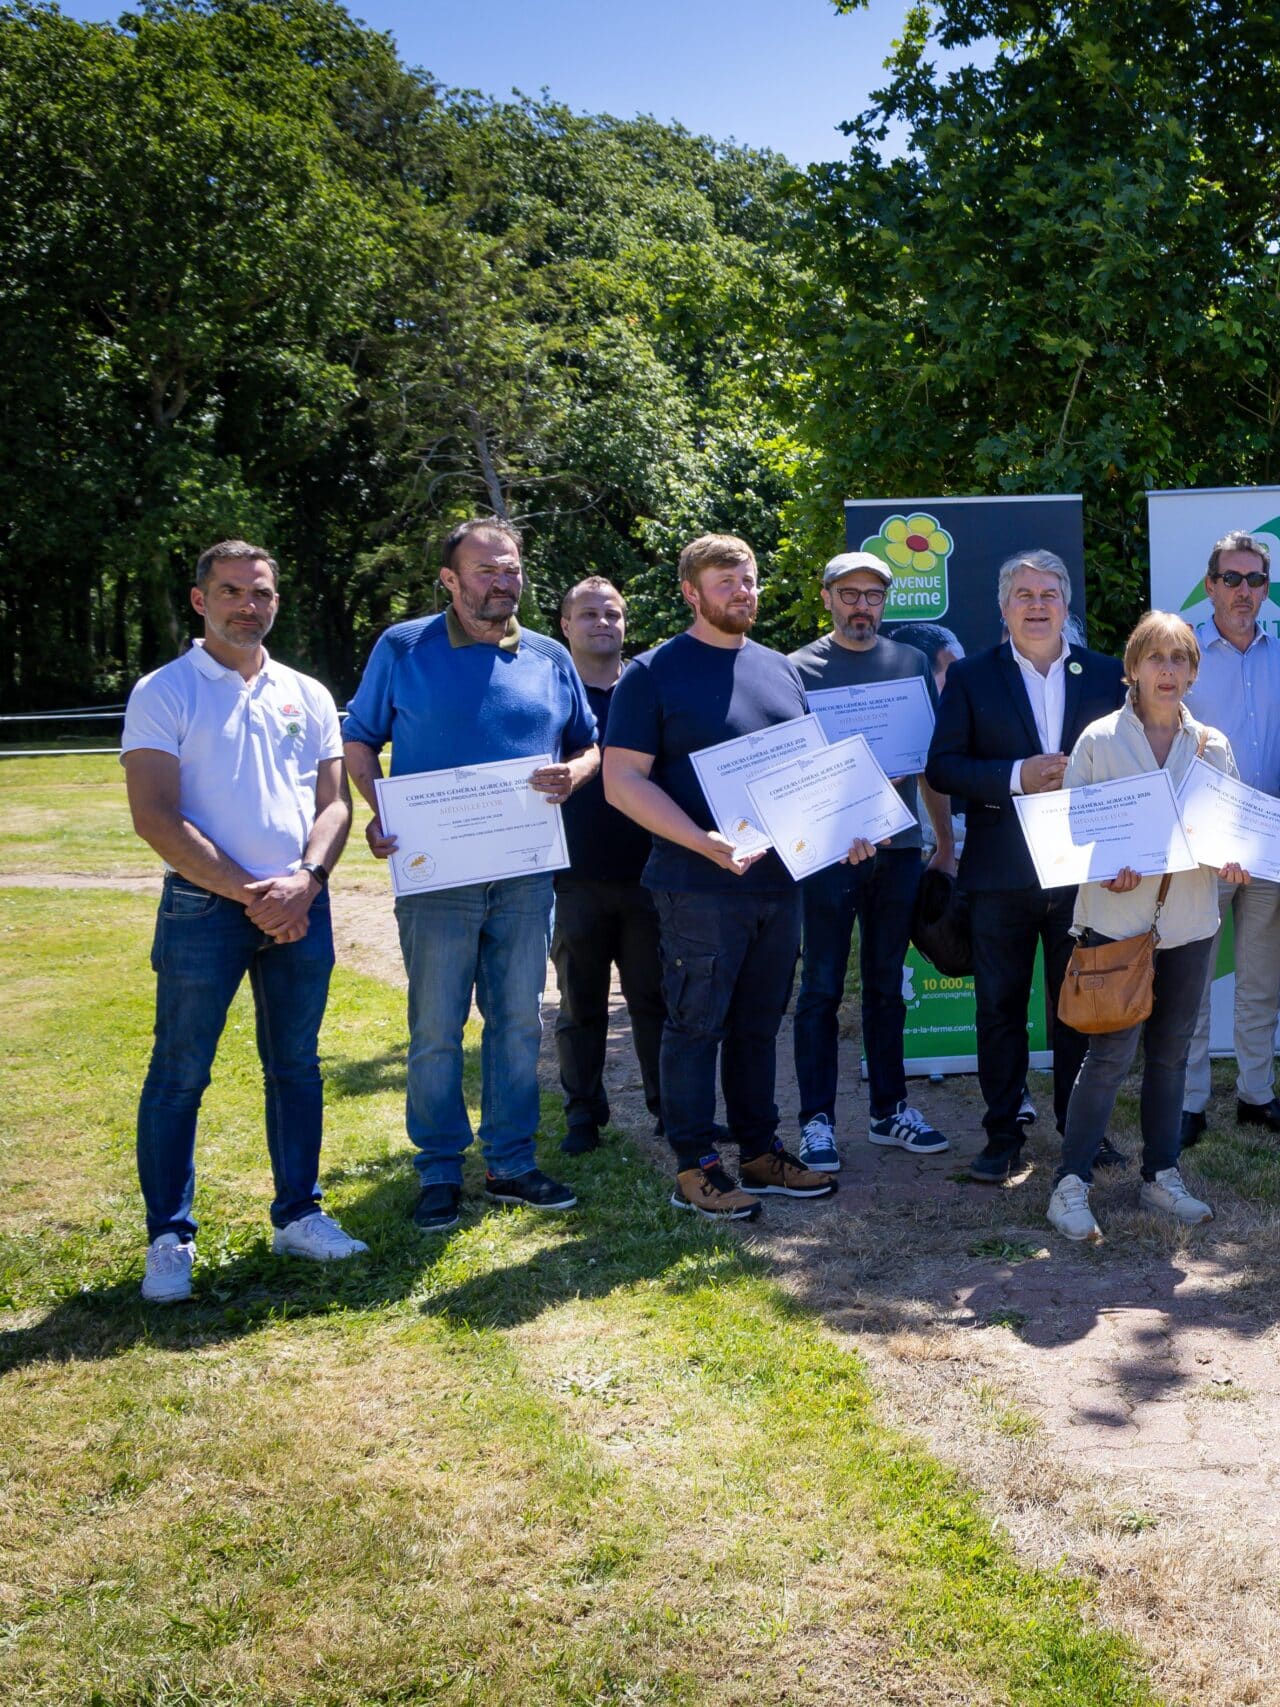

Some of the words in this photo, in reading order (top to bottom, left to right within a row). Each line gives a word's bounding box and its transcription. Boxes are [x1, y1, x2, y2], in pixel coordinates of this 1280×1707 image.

[890, 576, 942, 589] NVENUE
[890, 590, 941, 606] ferme
[812, 704, 843, 714] CONCOURS
[843, 699, 867, 709] GÉNÉRAL
[869, 696, 895, 706] AGRICOLE
[716, 756, 747, 772] CONCOURS
[406, 790, 446, 802] CONCOURS
[446, 784, 478, 796] GÉNÉRAL
[479, 780, 512, 792] AGRICOLE
[769, 780, 798, 796] CONCOURS
[408, 798, 439, 808] CONCOURS
[440, 796, 451, 804] DES
[451, 792, 478, 802] PRODUITS
[1077, 799, 1104, 810] GÉNÉRAL
[1106, 794, 1137, 805] AGRICOLE
[1138, 792, 1151, 800] 2026
[922, 978, 938, 991] 10
[940, 977, 964, 990] 000
